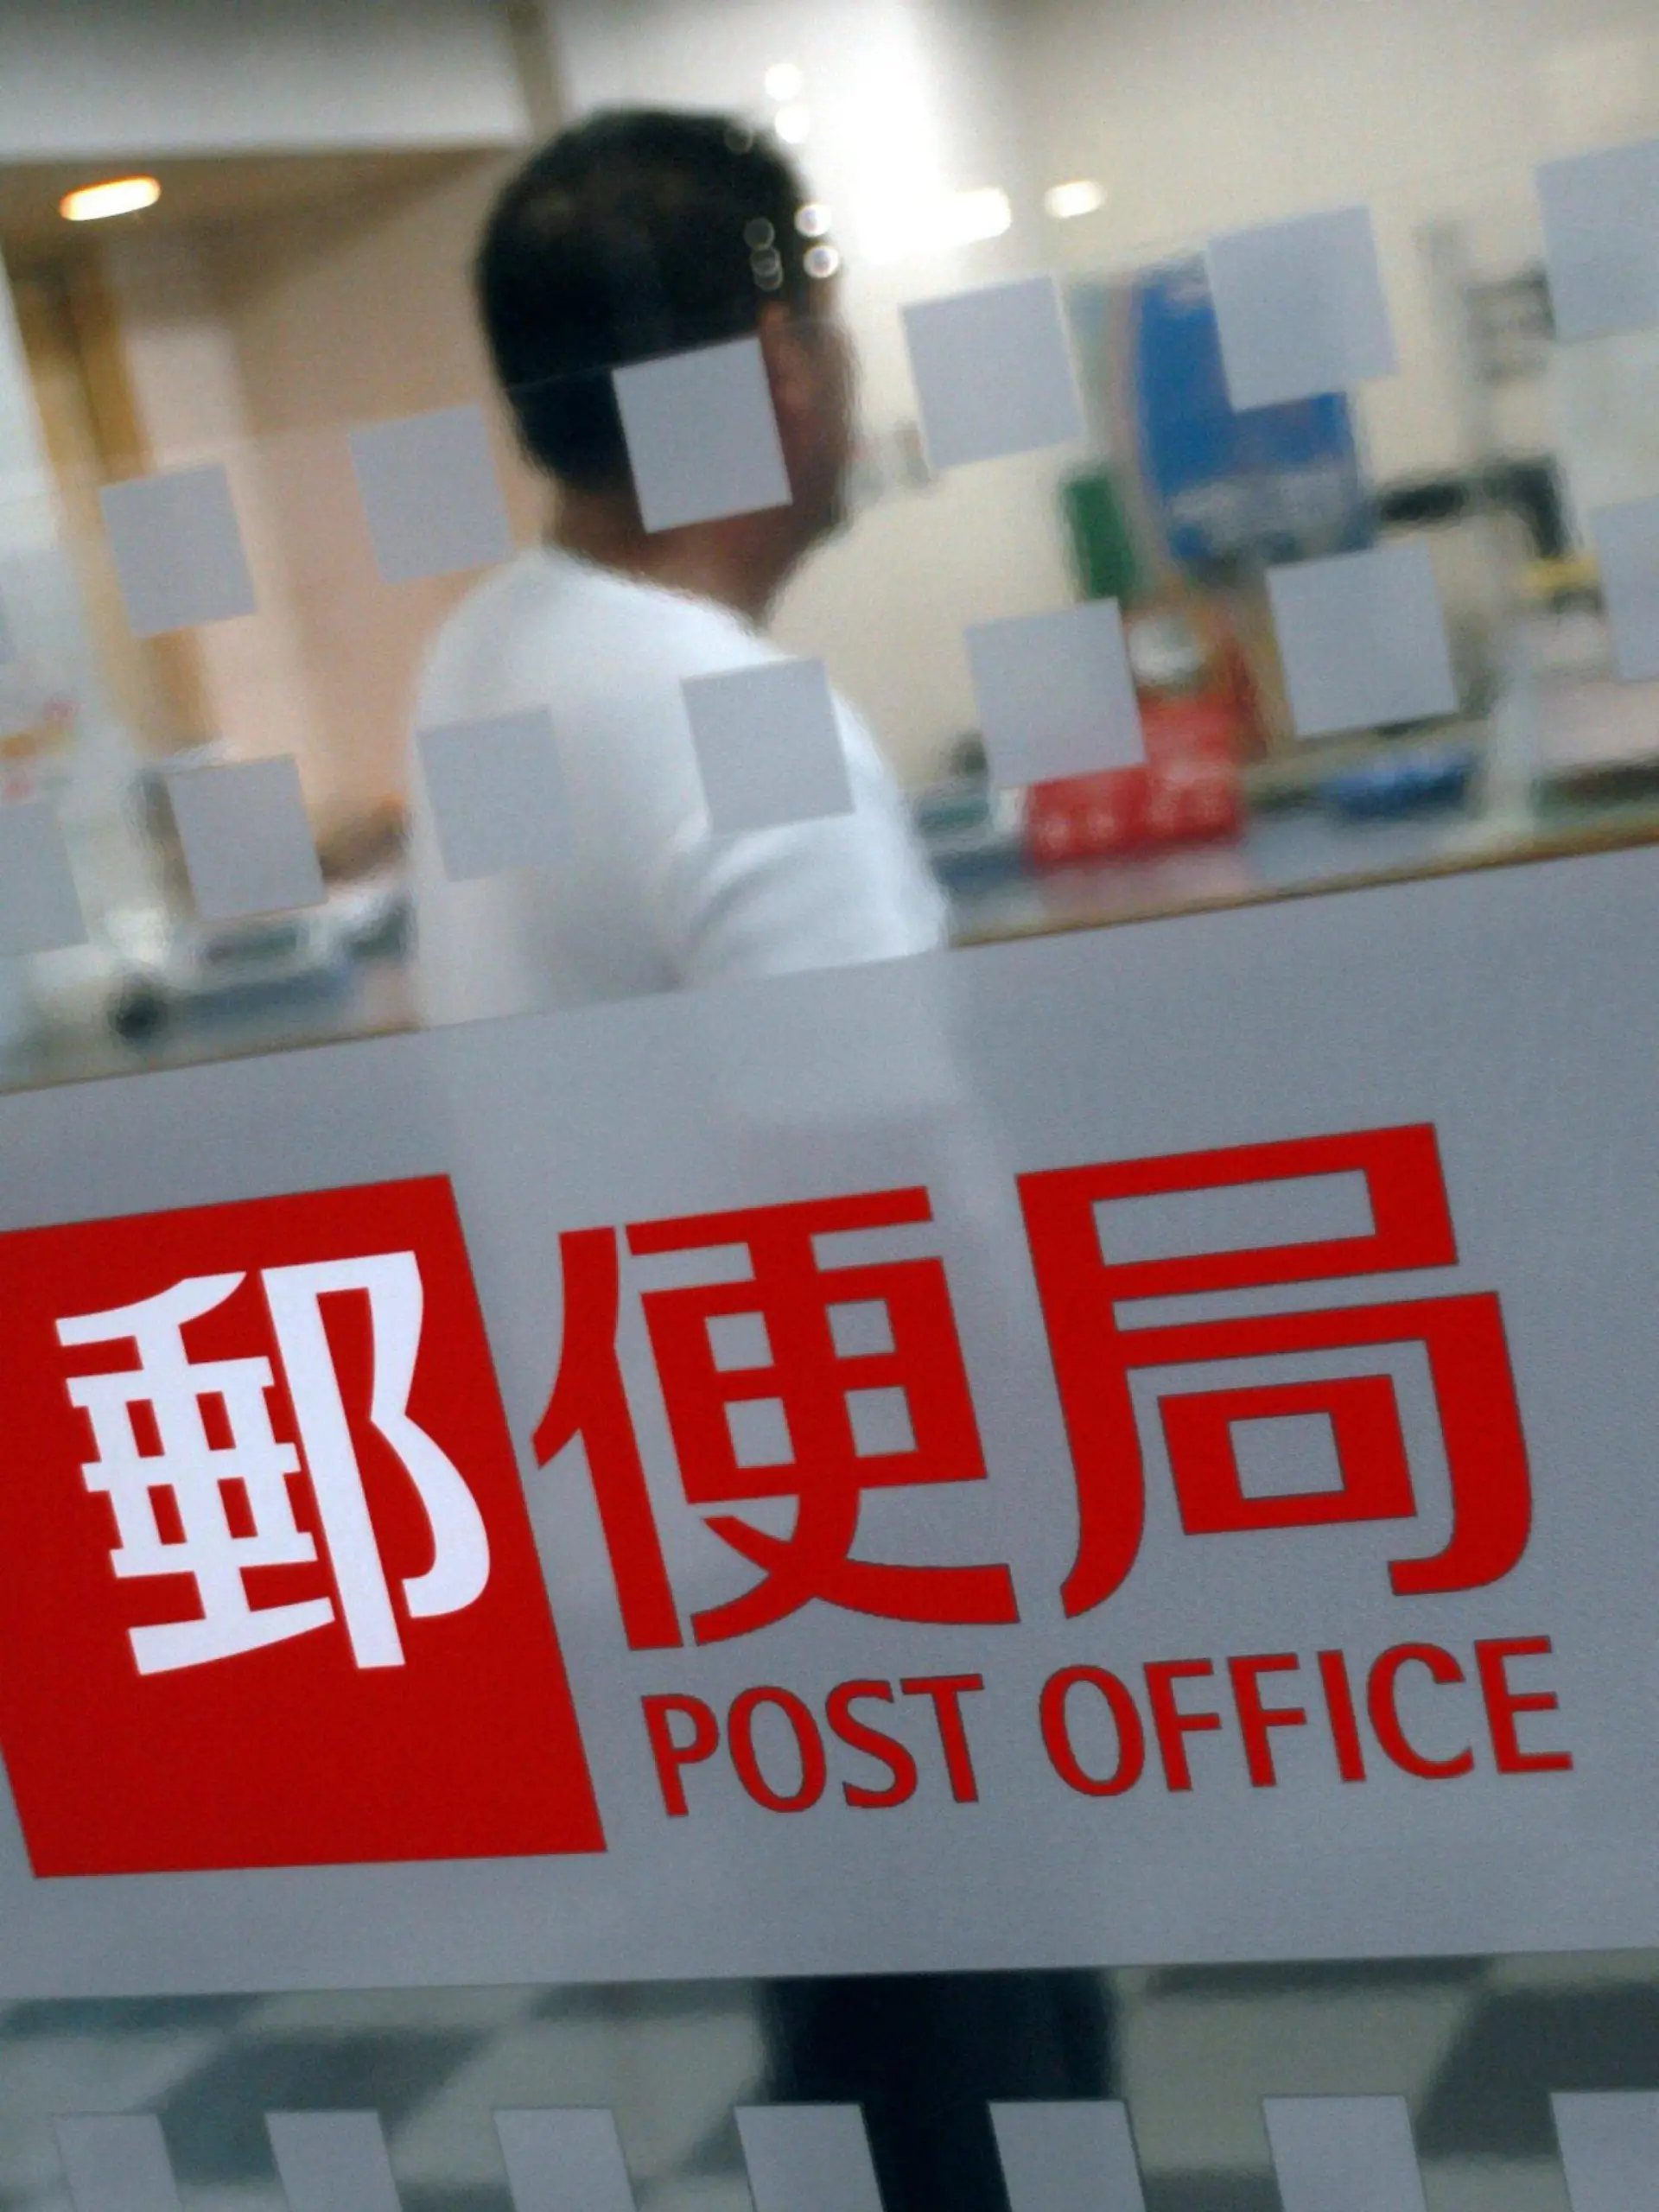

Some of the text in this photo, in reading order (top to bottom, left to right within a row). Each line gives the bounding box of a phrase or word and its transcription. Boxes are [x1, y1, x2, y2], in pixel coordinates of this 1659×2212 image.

[55, 1123, 1532, 1675] 郵便局
[642, 1636, 1572, 1817] POST OFFICE
